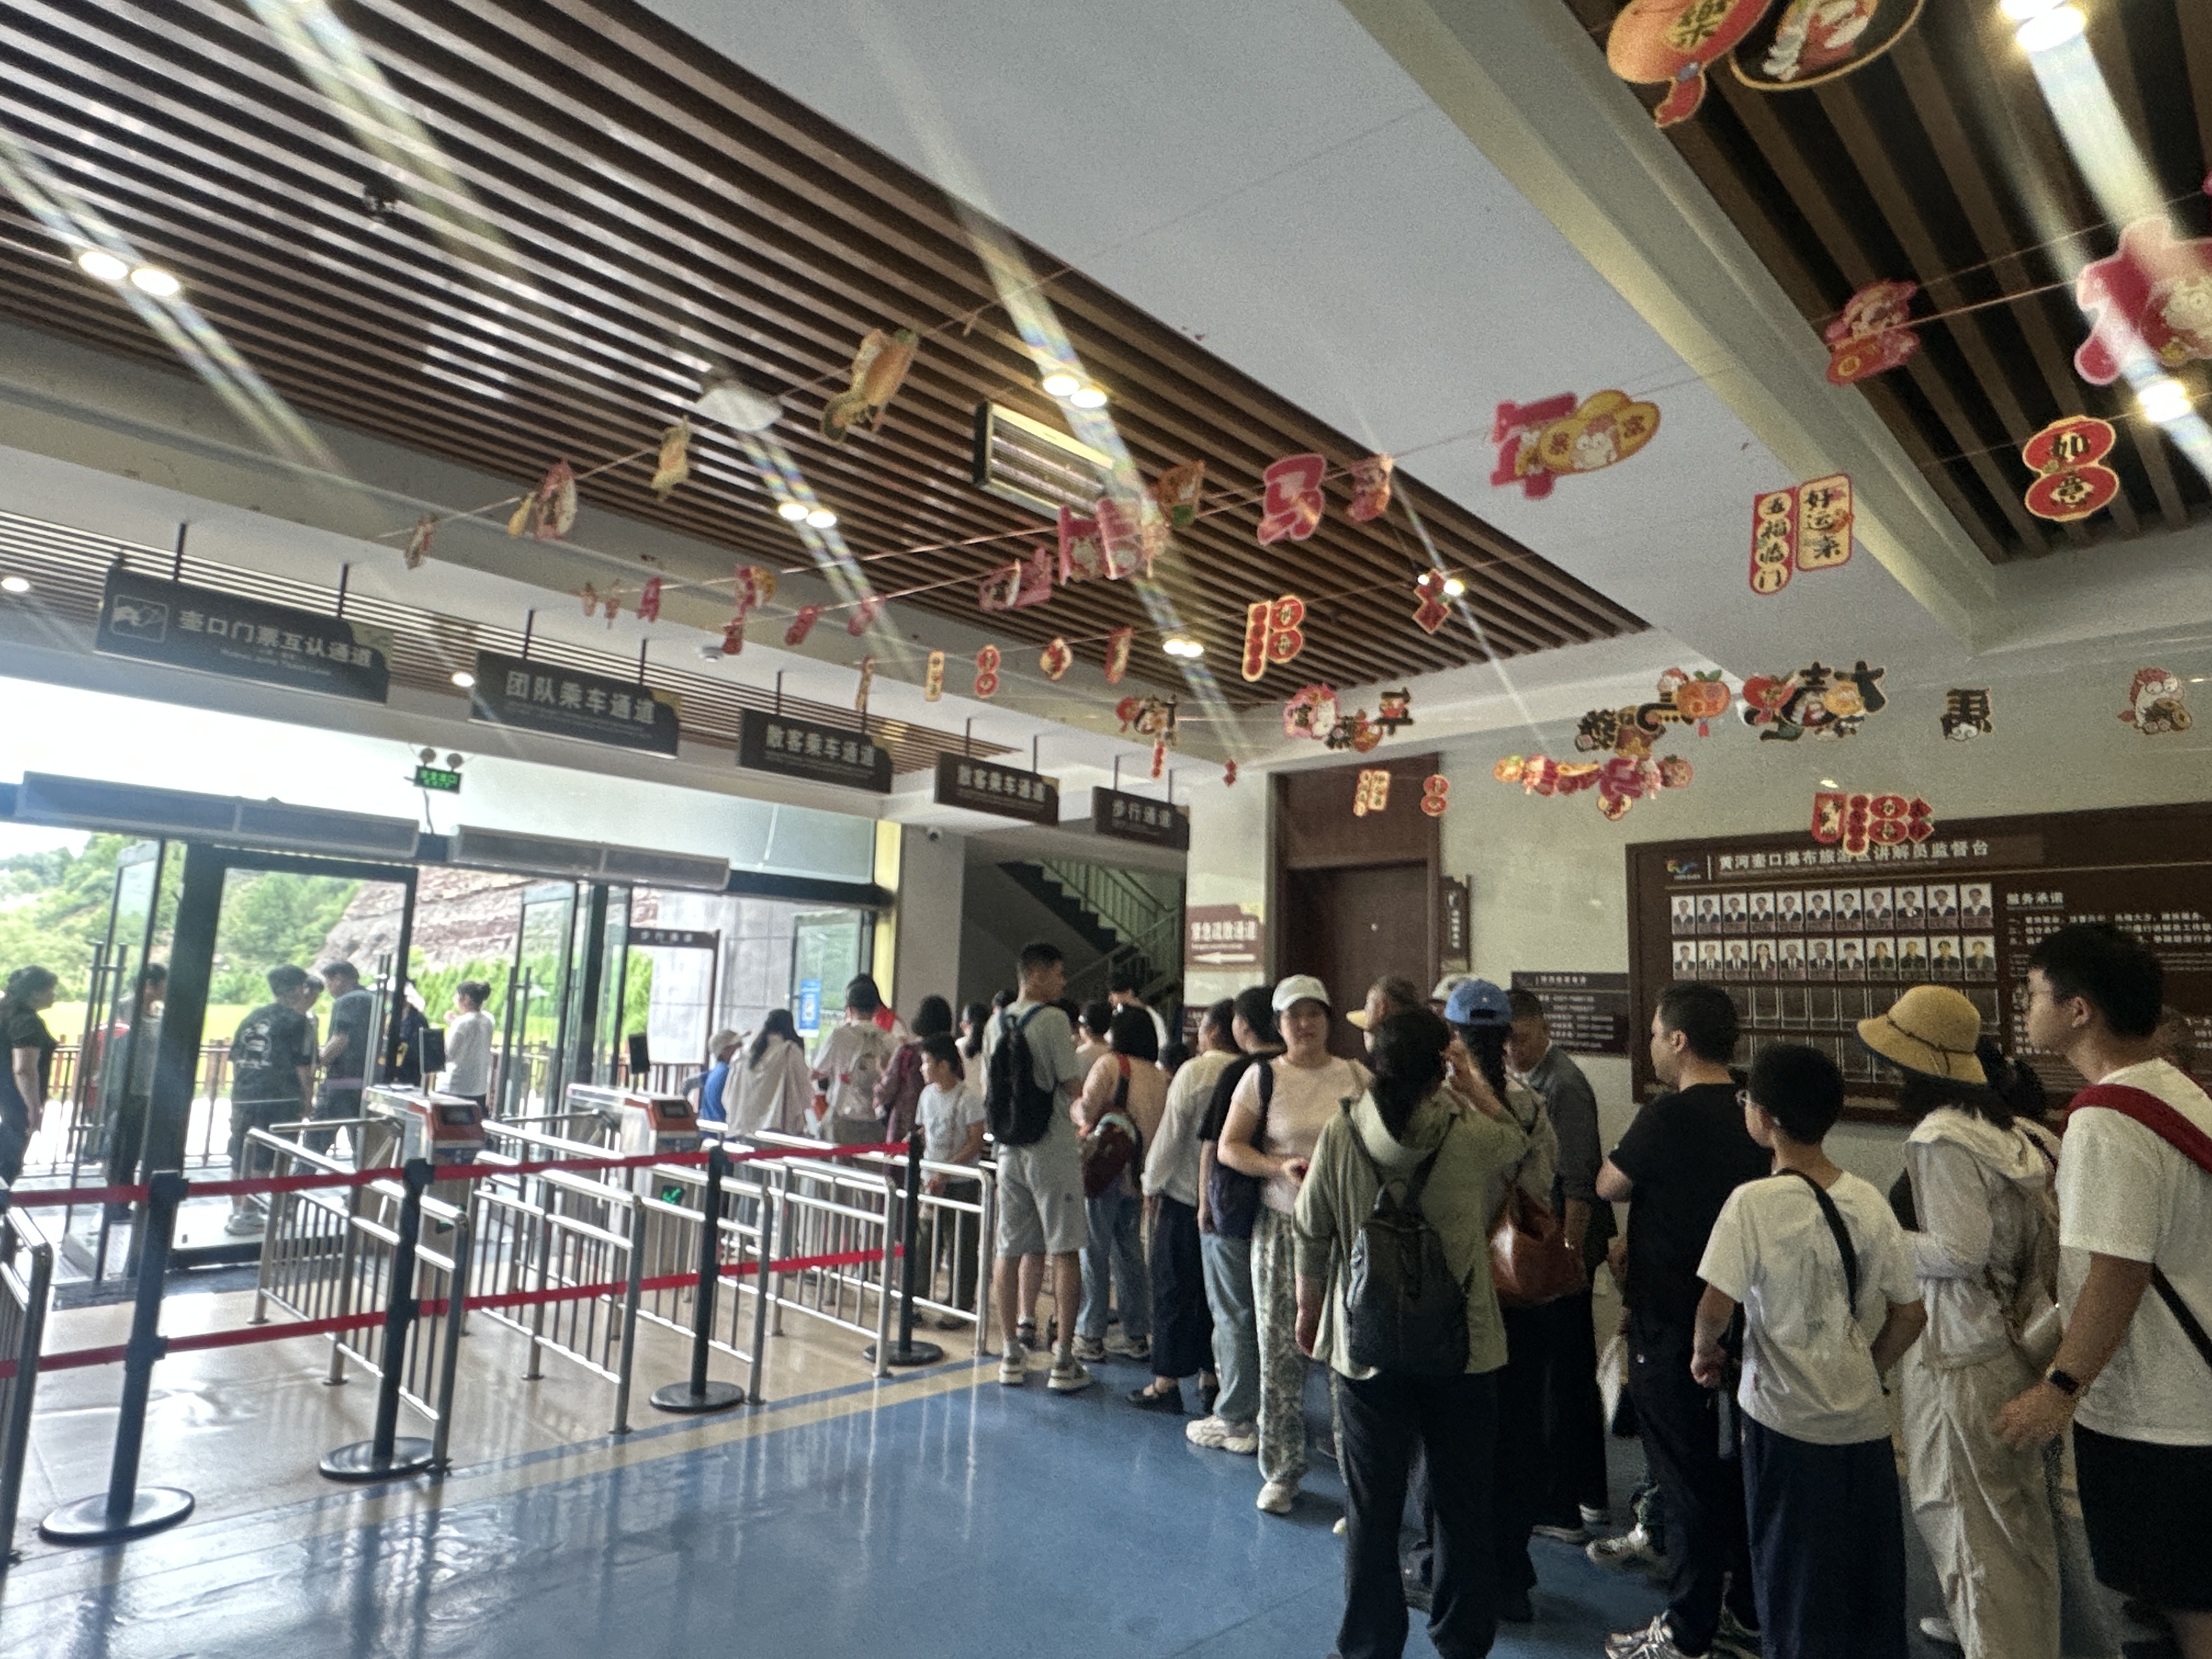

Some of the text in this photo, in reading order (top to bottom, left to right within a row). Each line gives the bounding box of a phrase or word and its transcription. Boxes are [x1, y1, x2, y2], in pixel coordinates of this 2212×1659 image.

[1758, 496, 1787, 589] 五福临门
[1805, 488, 1841, 559] 好运来
[178, 610, 373, 668] 壶口门票互认通道
[505, 670, 656, 724] 团队乘车通道
[766, 724, 876, 767] 散客乘车通道
[1111, 799, 1172, 828] 步行通道
[1190, 920, 1257, 941] 紧急疏散通道
